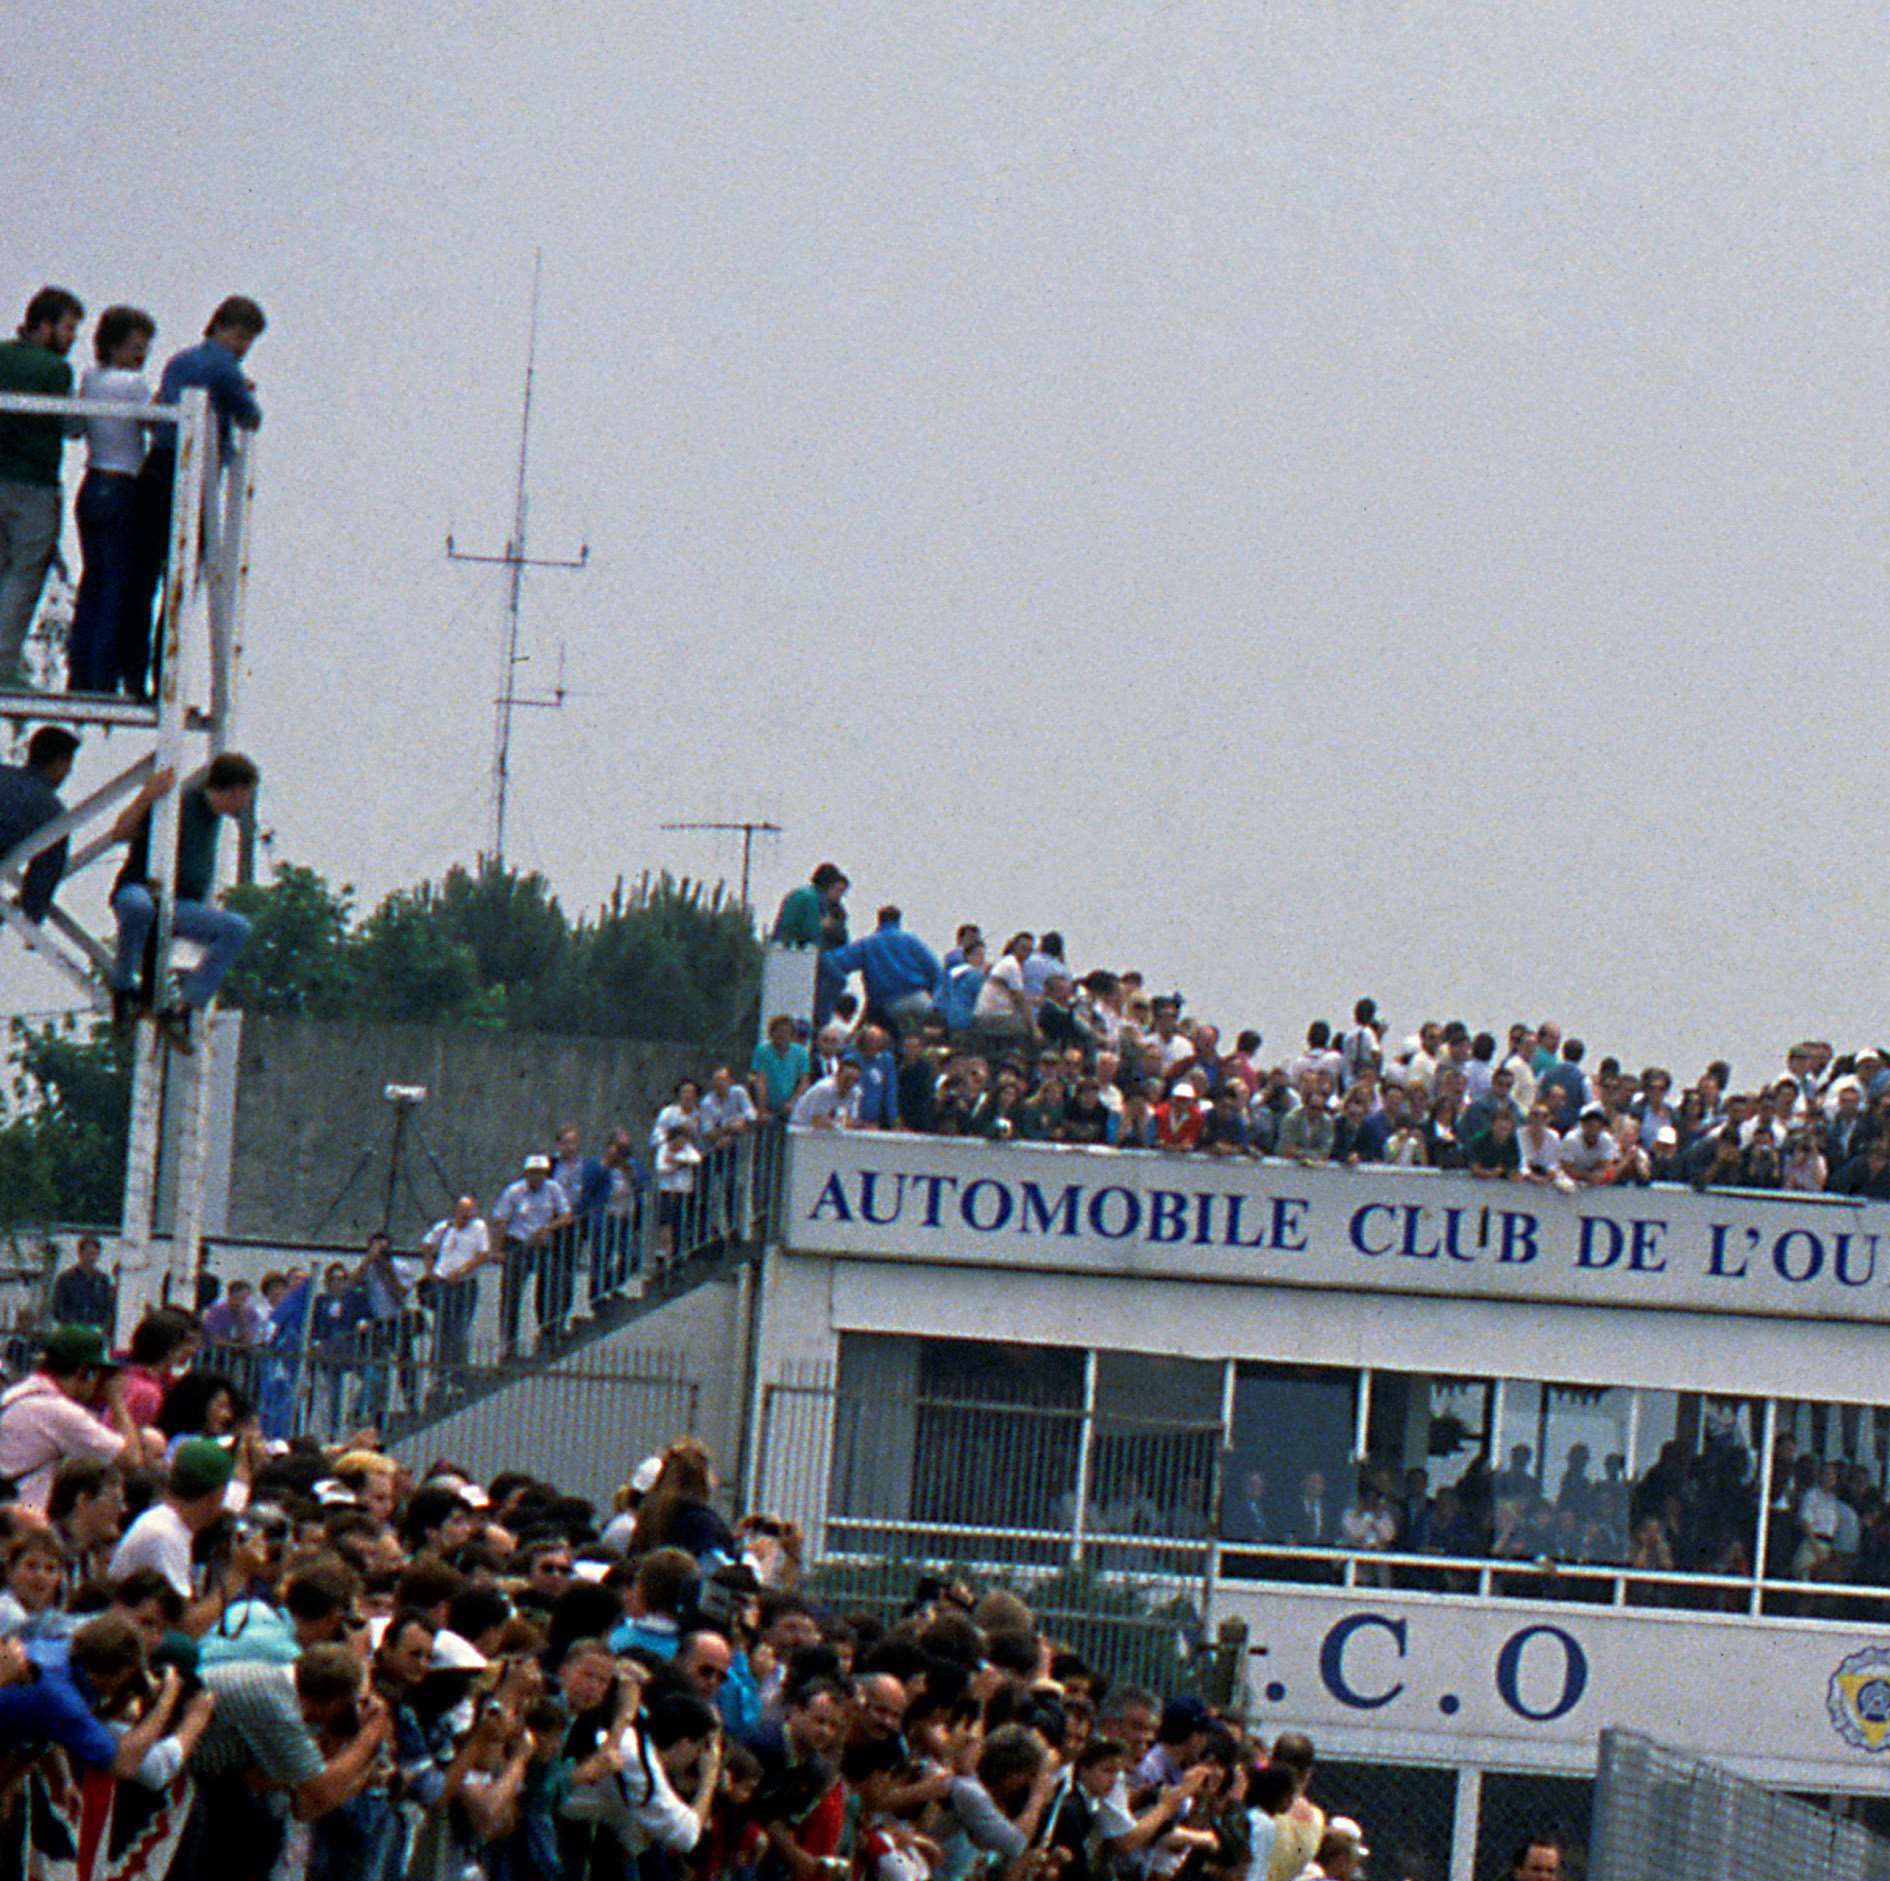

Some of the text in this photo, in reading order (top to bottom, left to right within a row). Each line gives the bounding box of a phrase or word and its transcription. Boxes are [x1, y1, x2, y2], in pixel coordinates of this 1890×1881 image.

[809, 1170, 1312, 1254] AUTOMOBILE
[1348, 1201, 1540, 1266] CLUB
[1576, 1215, 1668, 1276] DE
